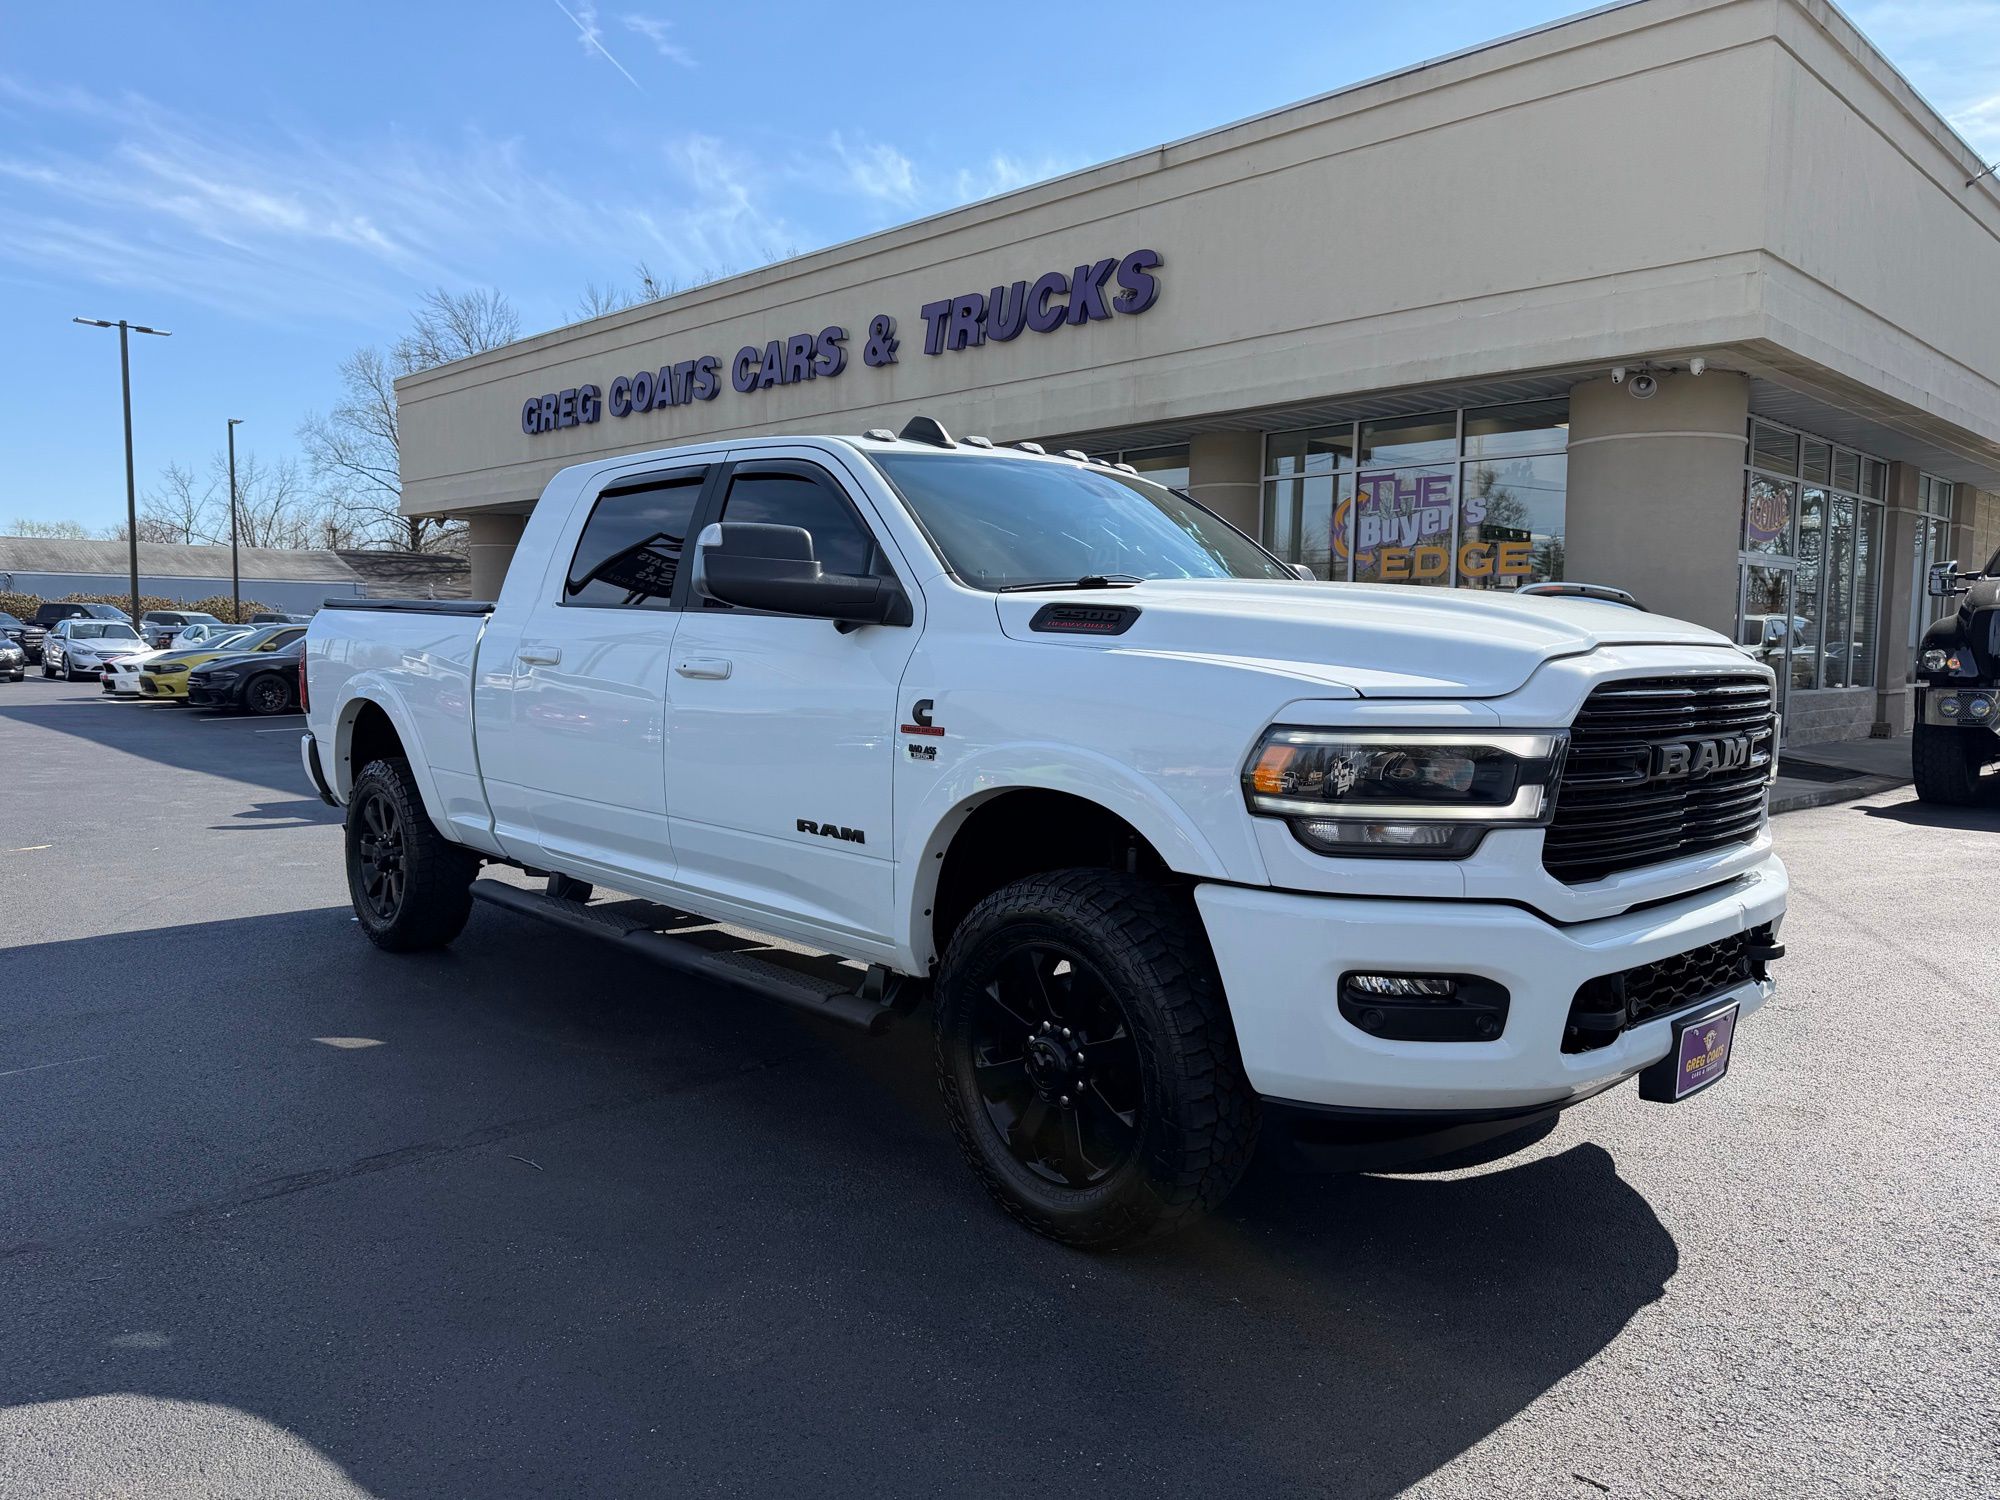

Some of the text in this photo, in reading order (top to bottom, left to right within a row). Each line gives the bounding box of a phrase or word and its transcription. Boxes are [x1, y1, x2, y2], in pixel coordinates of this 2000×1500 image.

[522, 249, 1164, 434] GREG COATS CARS & TRUCKS
[1359, 473, 1453, 514] THE
[1379, 541, 1533, 579] EDGE
[1053, 608, 1121, 622] 2500
[908, 744, 937, 755] BAD ASS
[1657, 736, 1749, 776] RAM
[796, 818, 866, 845] RAM
[1686, 1045, 1724, 1072] GREG COATS
